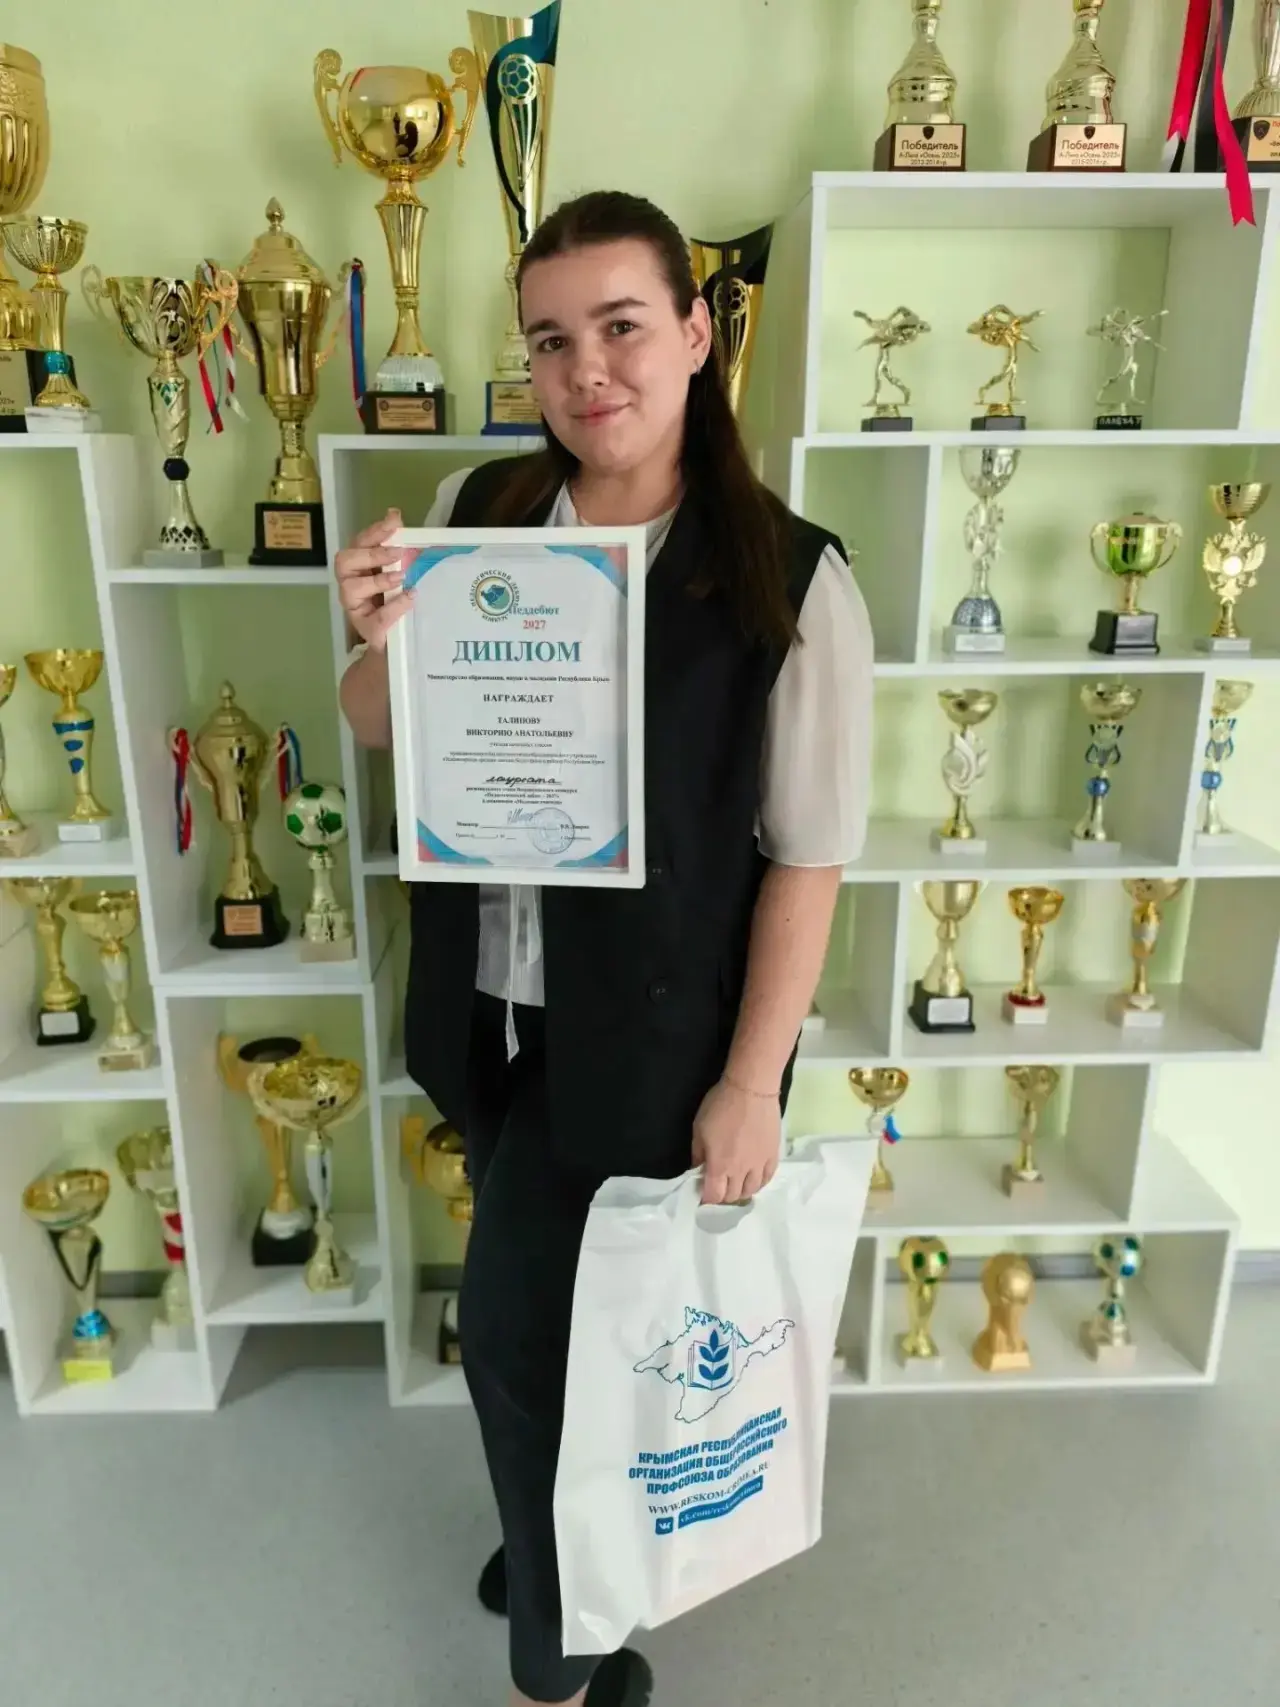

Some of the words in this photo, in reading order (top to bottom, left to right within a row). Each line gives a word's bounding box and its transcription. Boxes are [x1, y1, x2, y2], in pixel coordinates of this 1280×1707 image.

[901, 139, 959, 151] Победитель
[1061, 139, 1120, 151] Победитель
[509, 604, 560, 616] Педдебют
[452, 640, 583, 666] ДИПЛОМ
[427, 673, 468, 681] Министерство
[558, 675, 591, 683] Республики
[483, 694, 554, 704] НАГРАЖДАЕТ
[466, 728, 513, 737] ВИКТОРИЮ
[514, 729, 574, 738] АНАТОЛЬЕВНУ
[485, 775, 557, 788] лауреата
[638, 1443, 700, 1464] КРЫМСКАЯ
[701, 1406, 782, 1453] РЕСПУБЛИКАНСКАЯ
[628, 1457, 703, 1480] ОРГАНИЗАЦИЯ
[705, 1417, 788, 1467] ОБЩЕРОССИЙСКОГО
[646, 1468, 715, 1495] ПРОФСОЮЗА
[716, 1438, 774, 1480] ОБРАЗОВАНИЯ
